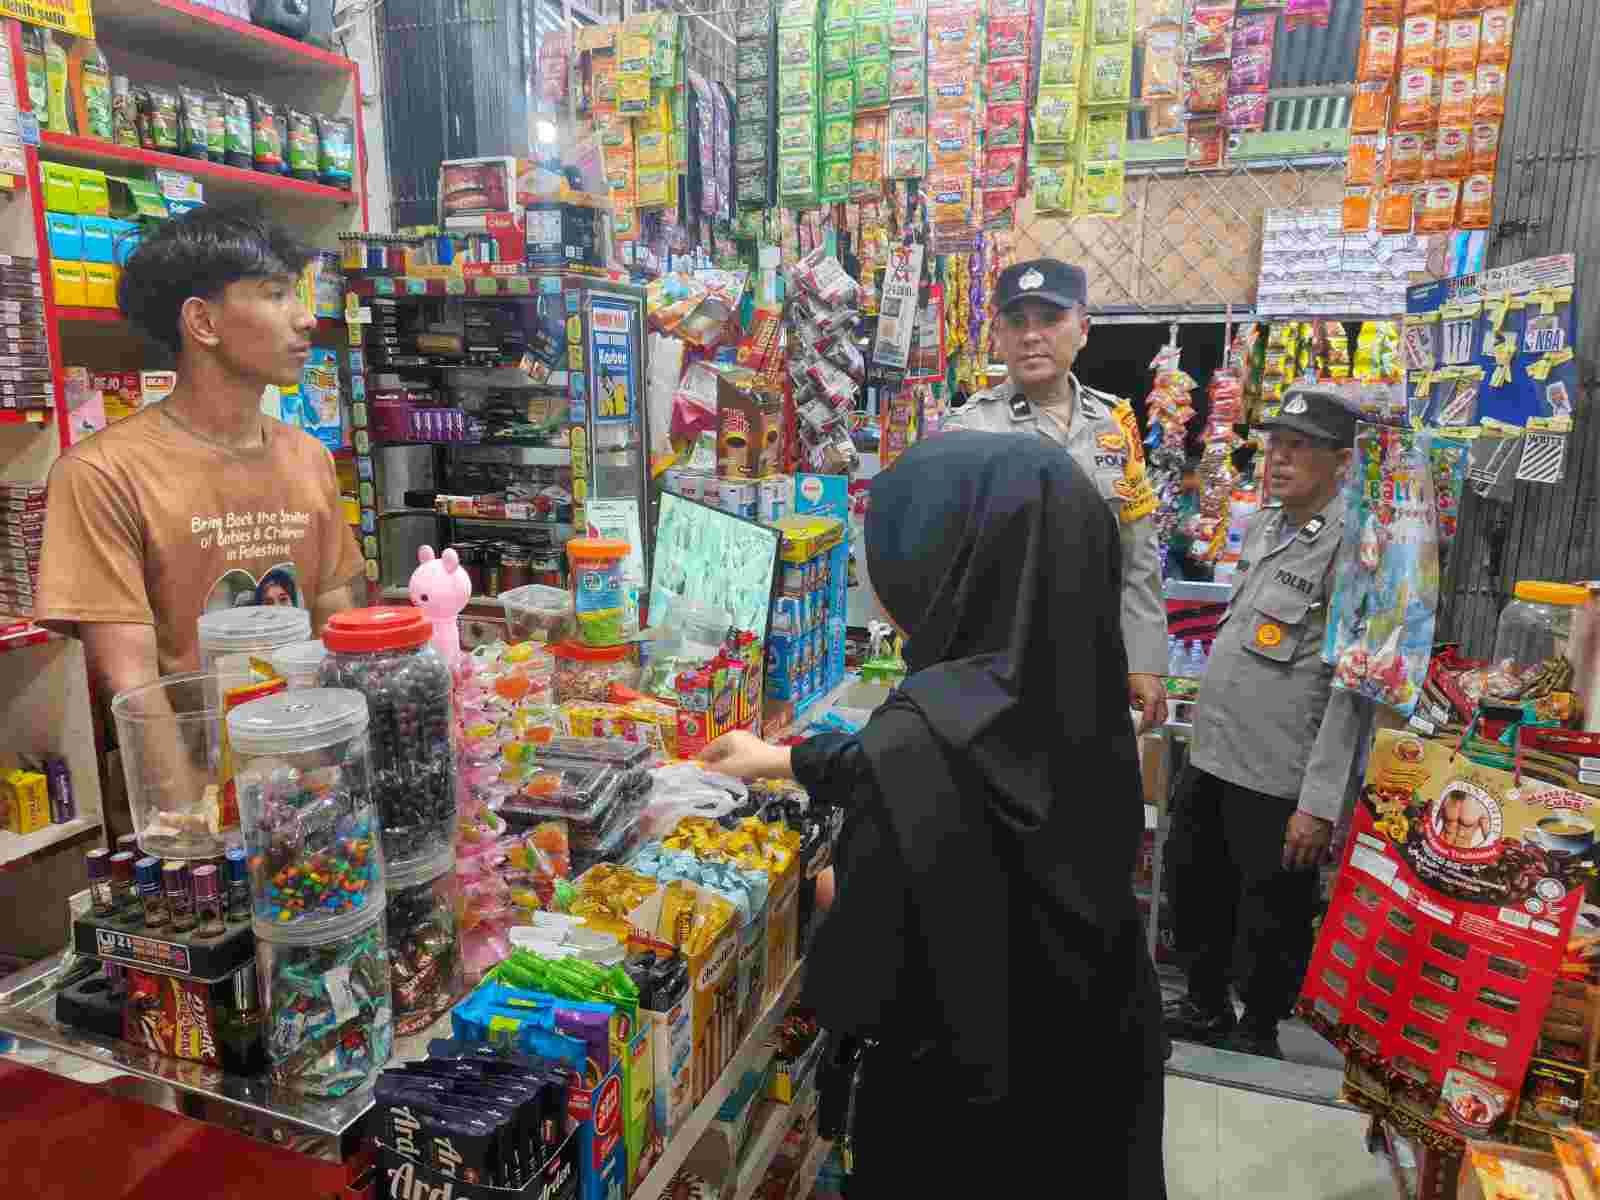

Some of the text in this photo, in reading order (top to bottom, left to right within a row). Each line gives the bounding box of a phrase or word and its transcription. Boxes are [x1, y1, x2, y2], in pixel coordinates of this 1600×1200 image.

[1536, 329, 1562, 350] NBA
[226, 512, 252, 528] Back
[256, 511, 277, 525] the
[227, 543, 291, 561] in Palestine
[1274, 568, 1315, 595] POLRI
